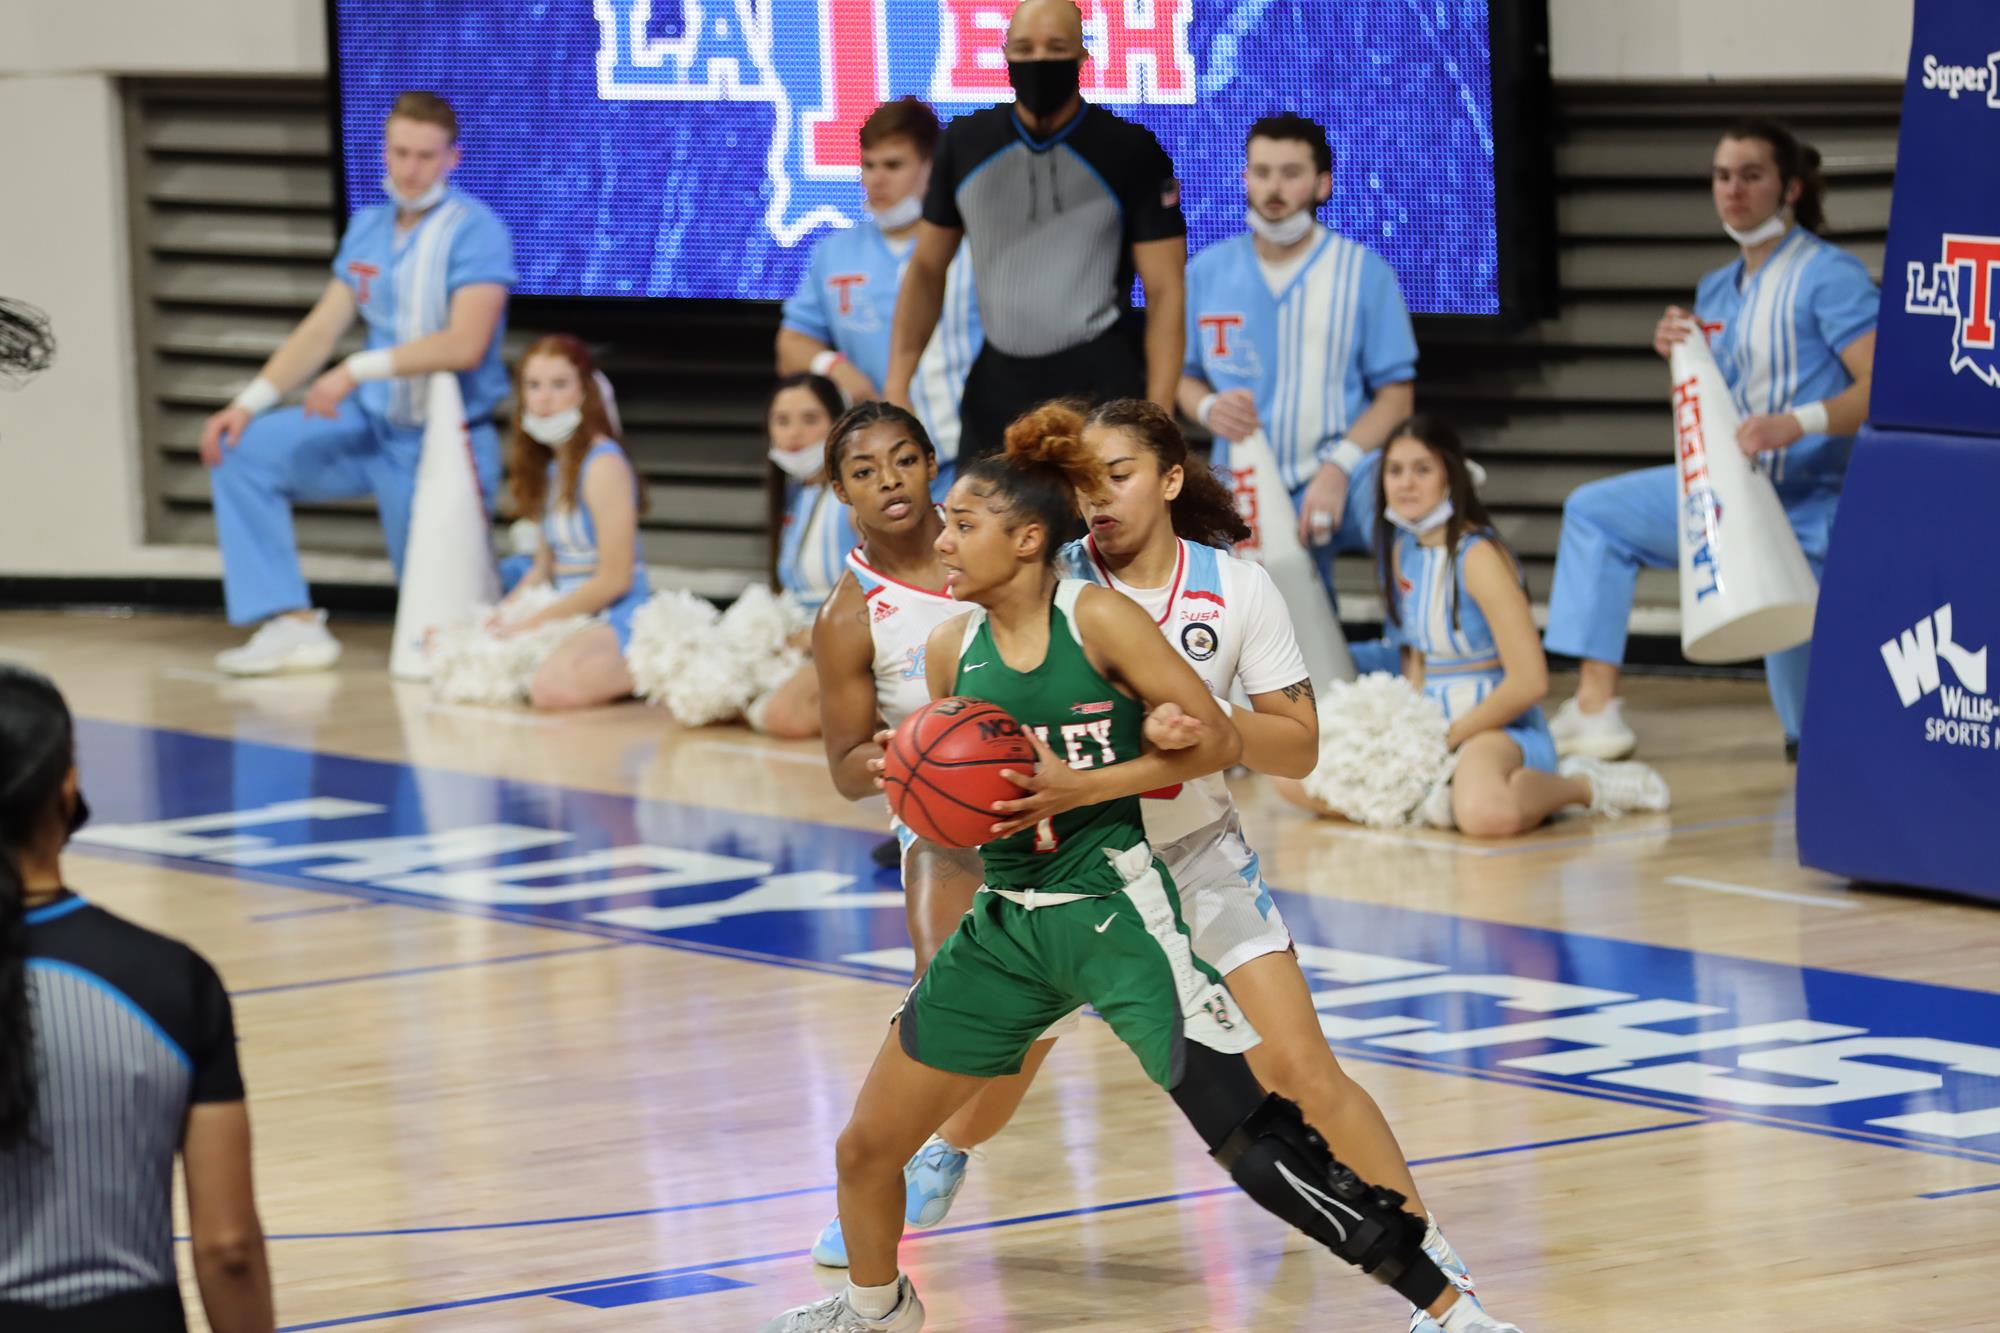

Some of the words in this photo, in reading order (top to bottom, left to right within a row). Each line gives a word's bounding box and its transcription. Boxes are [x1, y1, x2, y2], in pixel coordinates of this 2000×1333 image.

[1922, 54, 1989, 100] Super
[1905, 262, 1959, 316] LA
[1198, 314, 1243, 356] T
[1925, 717, 1990, 749] SPORTS
